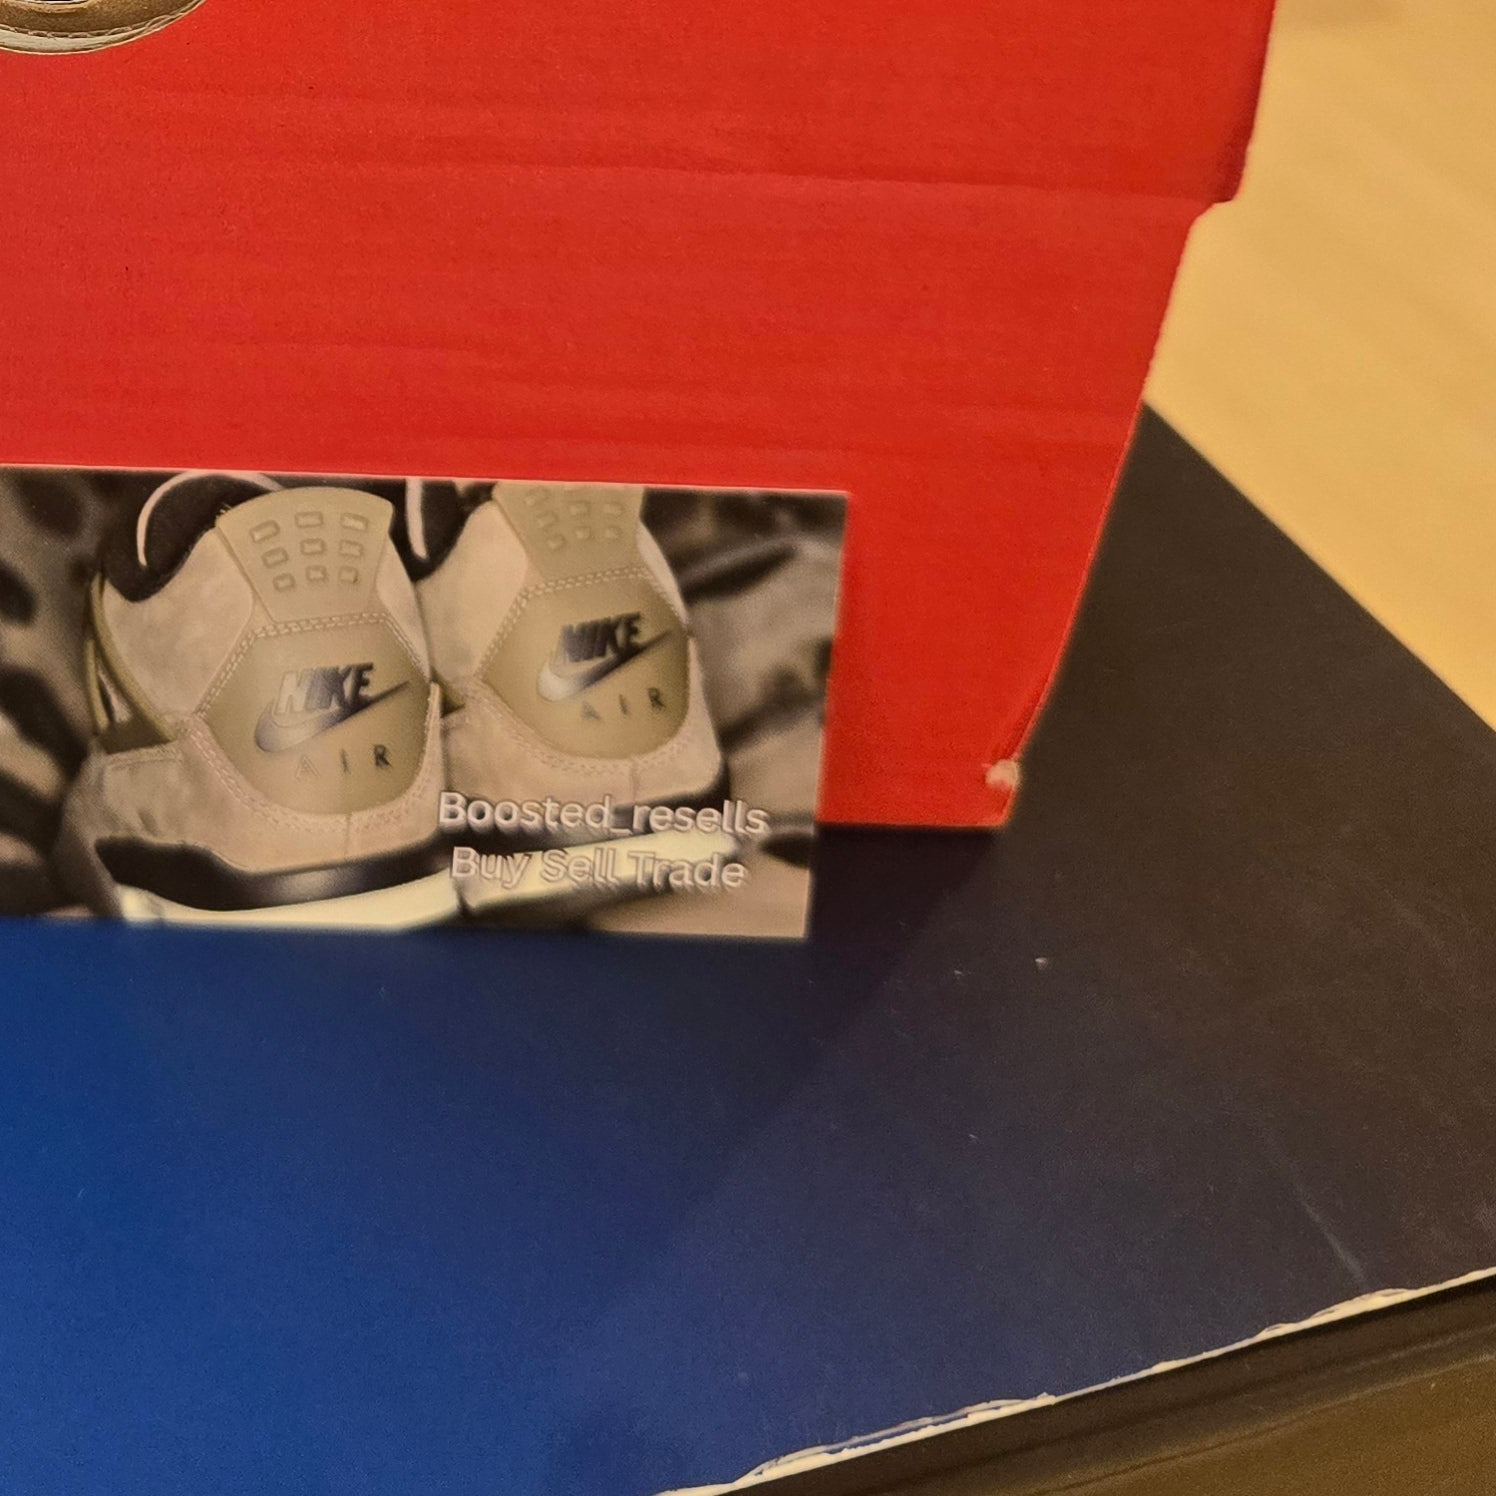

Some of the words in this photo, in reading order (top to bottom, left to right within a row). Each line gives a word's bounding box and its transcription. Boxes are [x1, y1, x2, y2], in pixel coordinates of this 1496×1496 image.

[558, 612, 641, 664] NIKE
[273, 662, 374, 715] NIKE
[439, 790, 770, 835] Boosted_resells
[451, 846, 531, 888] Buy
[540, 847, 619, 884] Sell
[627, 851, 747, 888] Trade
